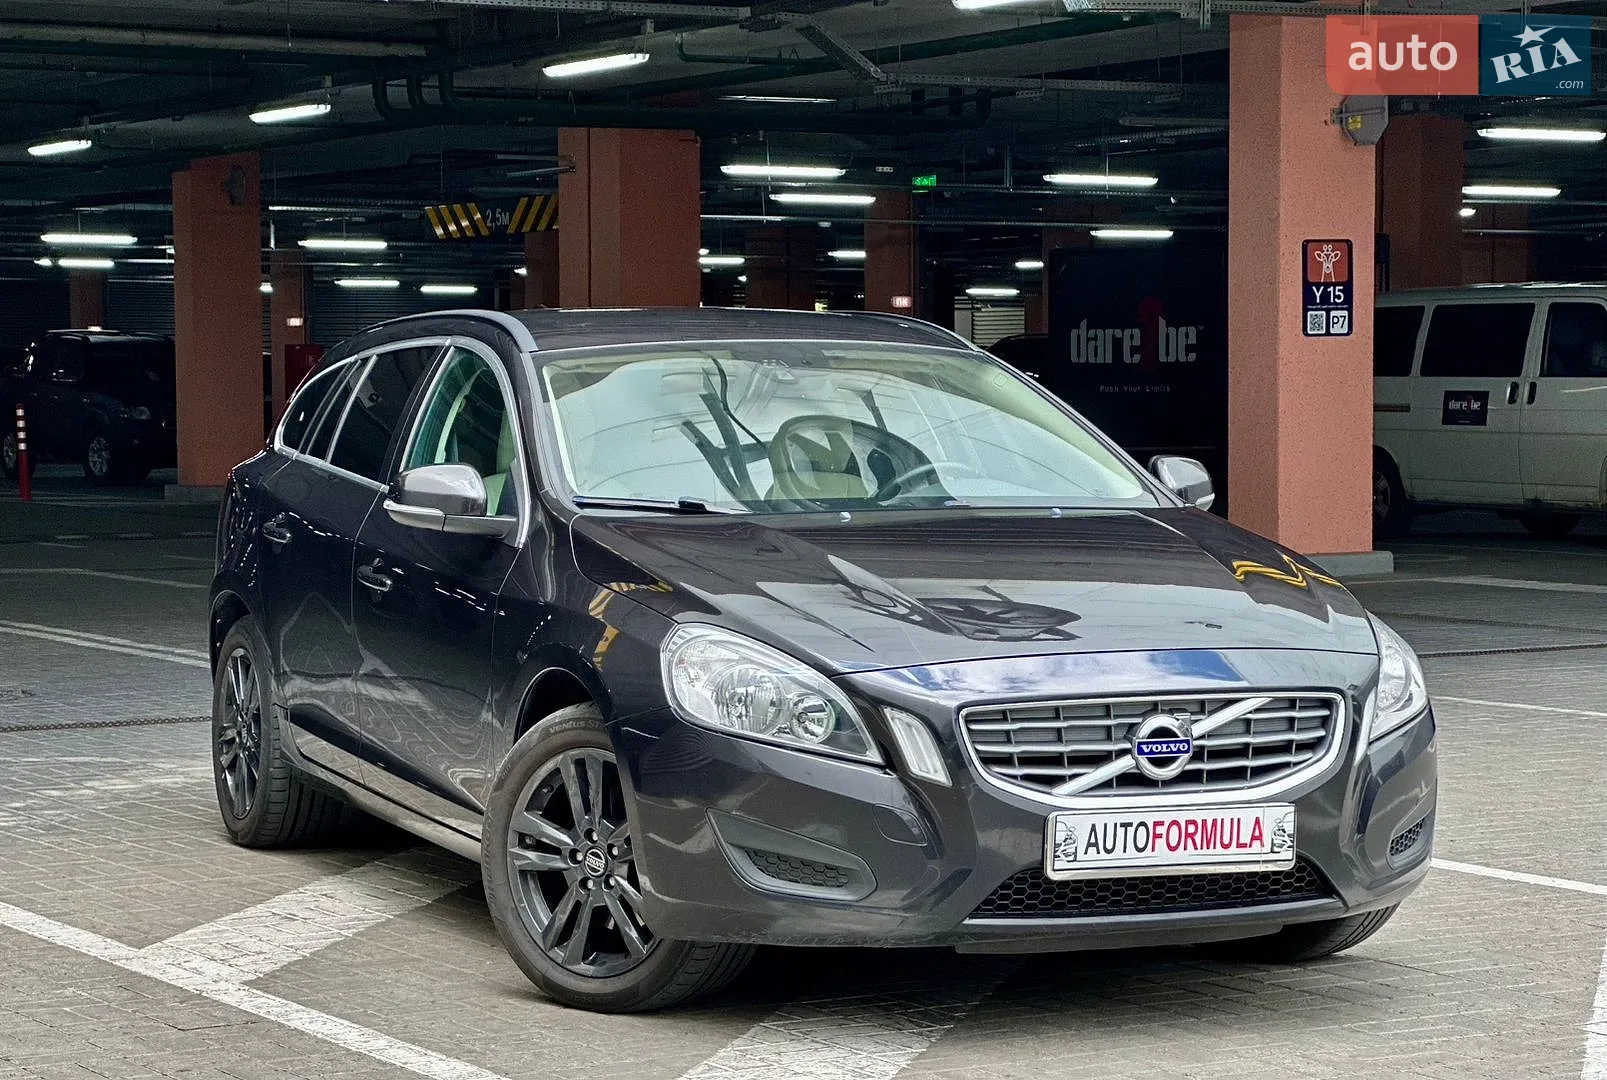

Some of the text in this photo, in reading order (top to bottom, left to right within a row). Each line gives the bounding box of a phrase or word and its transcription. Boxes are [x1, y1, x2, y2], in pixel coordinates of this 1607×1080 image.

[1312, 286, 1344, 303] Y 15
[1331, 315, 1346, 329] P7
[1070, 318, 1141, 363] dare
[1140, 742, 1189, 753] VOLVO
[1084, 816, 1265, 856] AUTOFORMULA
[586, 856, 604, 869] VOLVO
